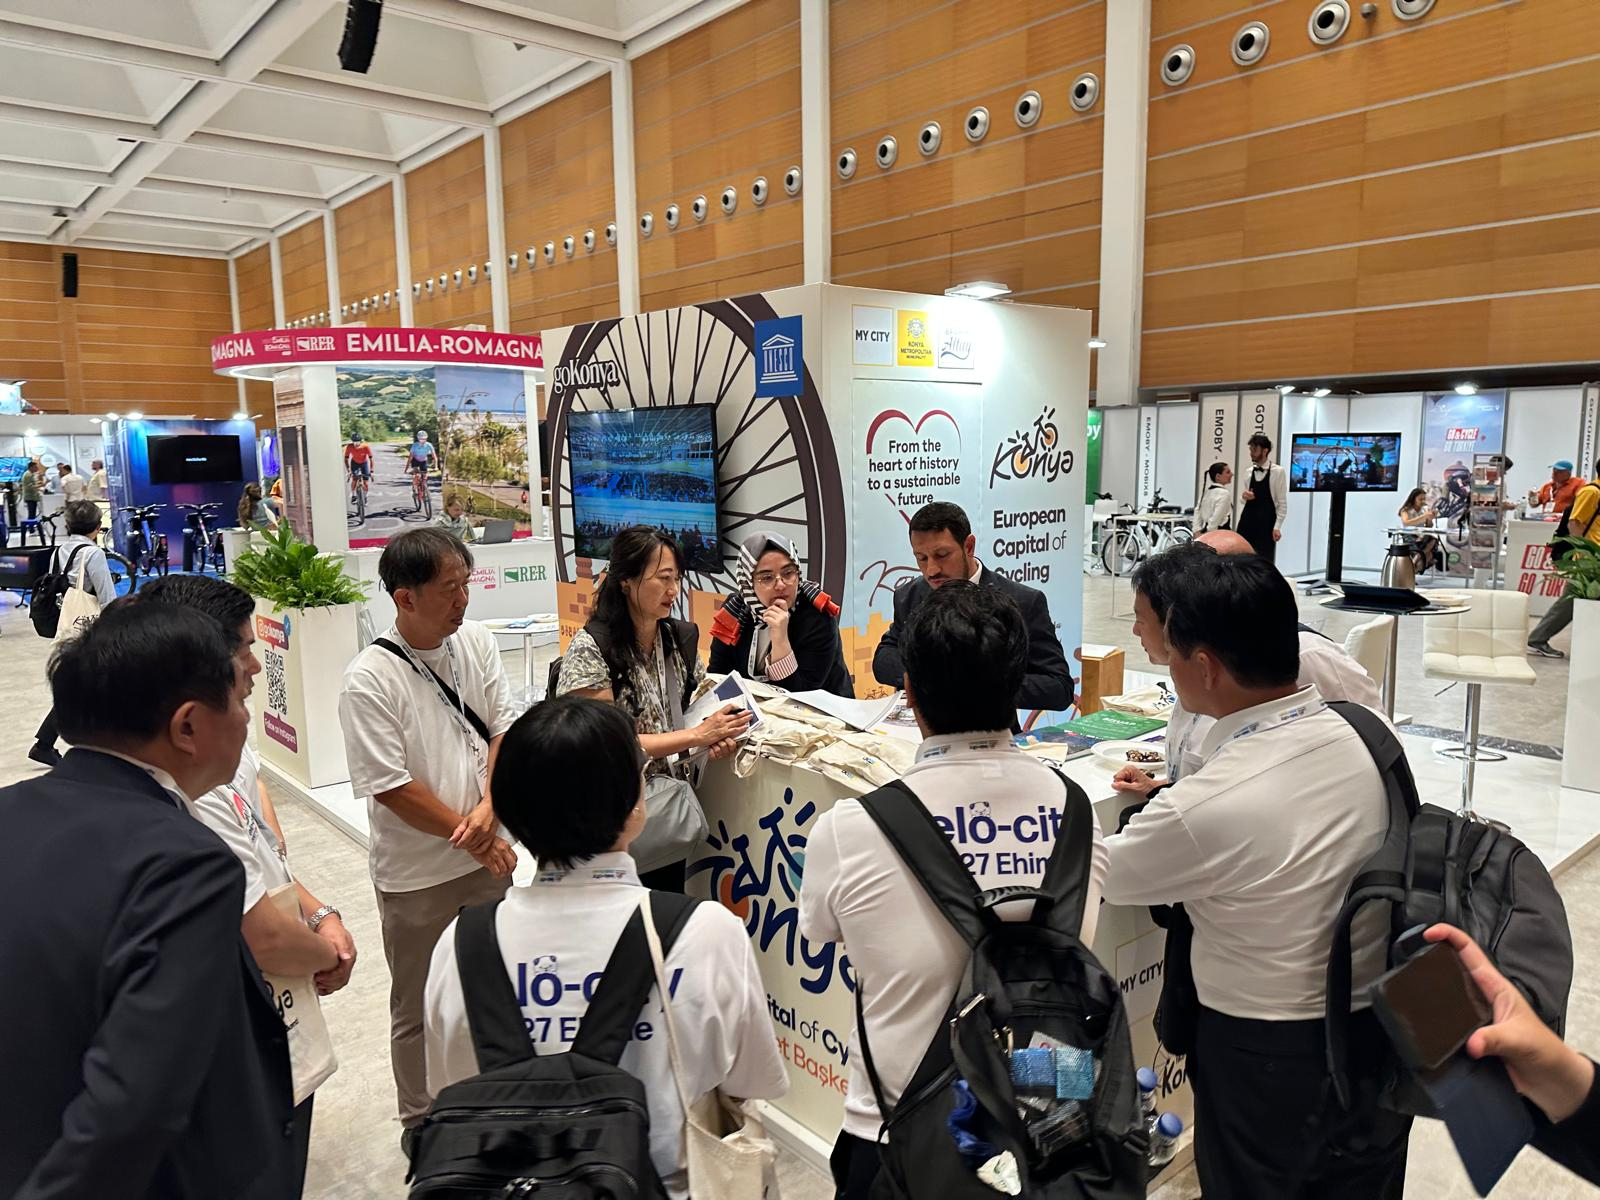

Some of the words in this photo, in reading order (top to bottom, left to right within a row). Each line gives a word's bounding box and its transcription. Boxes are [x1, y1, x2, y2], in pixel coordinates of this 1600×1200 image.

[347, 333, 543, 359] EMILIA-ROMAGNA
[855, 329, 869, 341] MY
[870, 331, 890, 342] CITY
[554, 358, 619, 394] goKonya
[1214, 409, 1225, 453] EMOBY
[889, 440, 919, 454] From
[922, 439, 941, 452] the
[869, 458, 902, 472] heart
[905, 457, 917, 470] of
[919, 456, 959, 473] history
[990, 440, 1074, 489] Konya
[867, 477, 881, 490] to
[883, 479, 891, 489] a
[894, 473, 960, 488] sustainable
[898, 493, 933, 506] future
[993, 508, 1066, 530] European
[993, 532, 1050, 559] Capital
[1052, 530, 1067, 551] of
[933, 805, 1063, 844] elo-cit
[963, 852, 991, 876] 27
[1120, 974, 1137, 993] MY
[1139, 960, 1163, 985] CITY
[526, 1017, 551, 1043] 27
[767, 993, 796, 1032] ital
[800, 1020, 819, 1043] of
[794, 1043, 848, 1096] Başke
